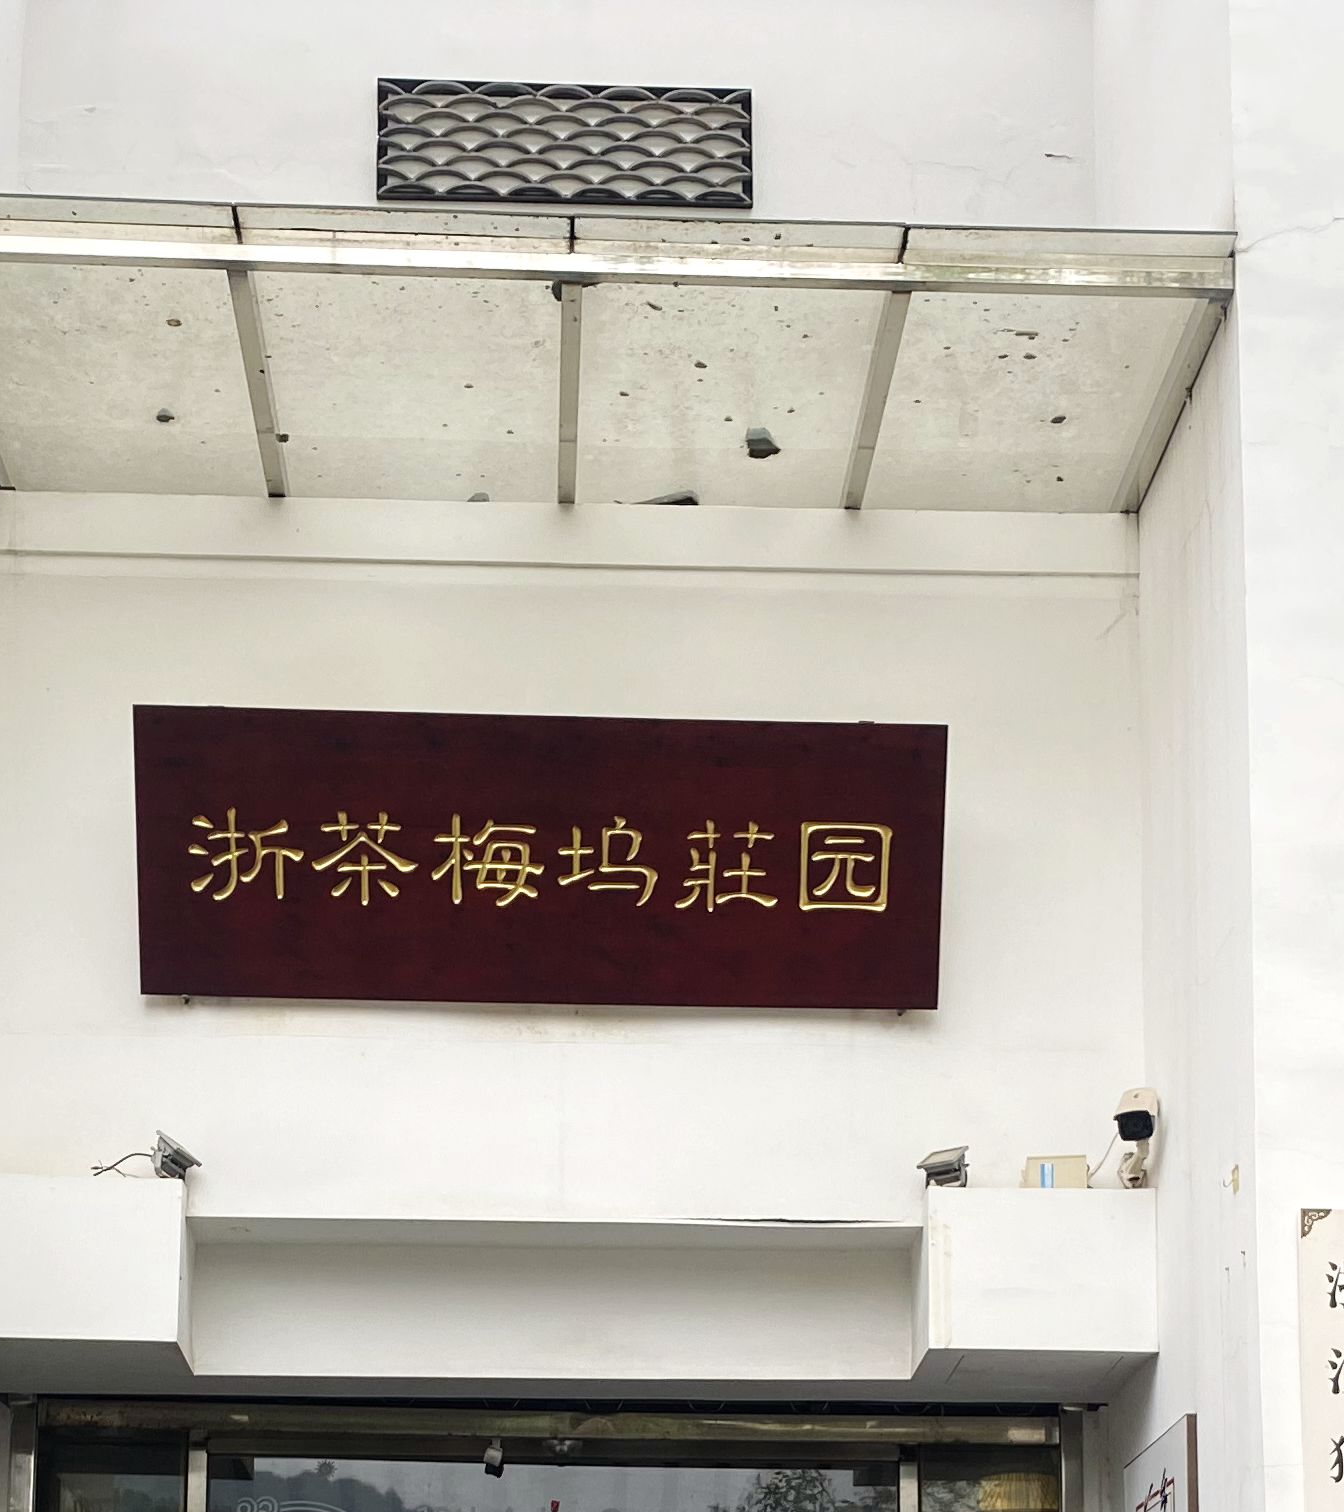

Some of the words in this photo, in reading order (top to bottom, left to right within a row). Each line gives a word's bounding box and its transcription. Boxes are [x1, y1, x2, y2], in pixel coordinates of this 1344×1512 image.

[188, 805, 894, 913] 浙茶梅坞莊园
